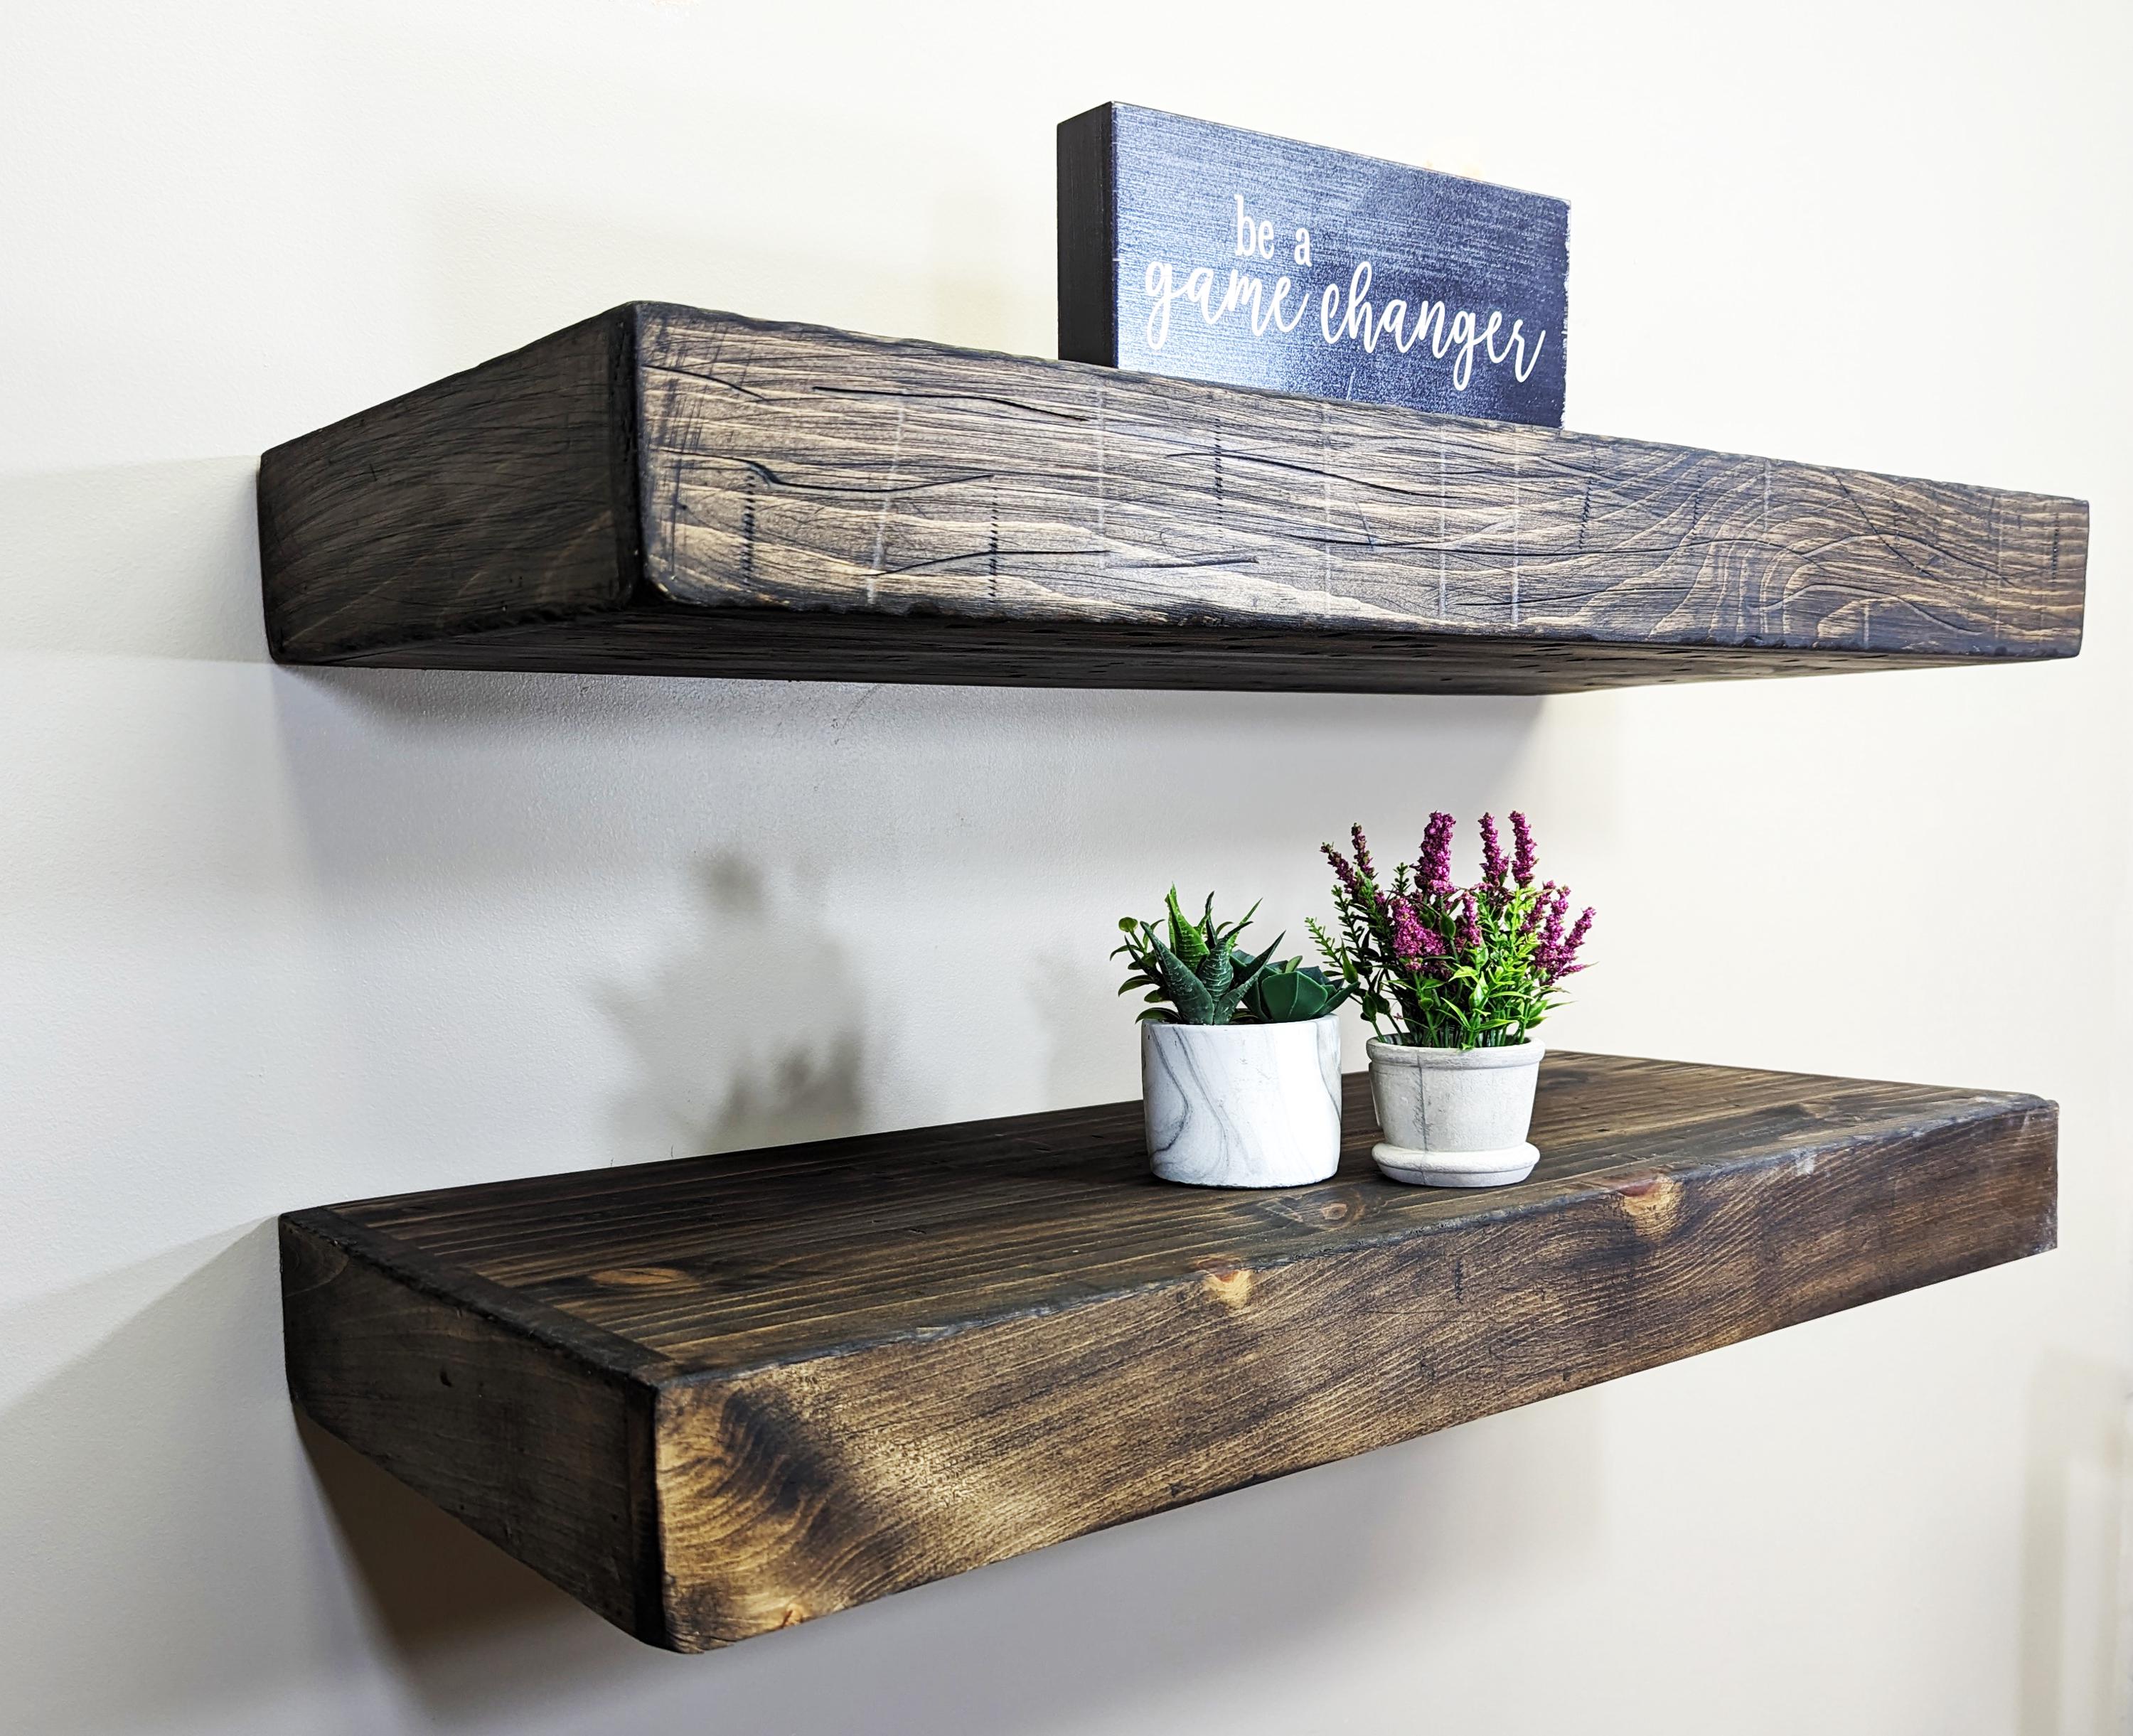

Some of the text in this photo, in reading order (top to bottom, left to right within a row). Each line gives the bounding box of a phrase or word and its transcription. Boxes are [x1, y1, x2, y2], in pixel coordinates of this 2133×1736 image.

[1234, 194, 1313, 267] be a
[1144, 259, 1546, 392] game changer
